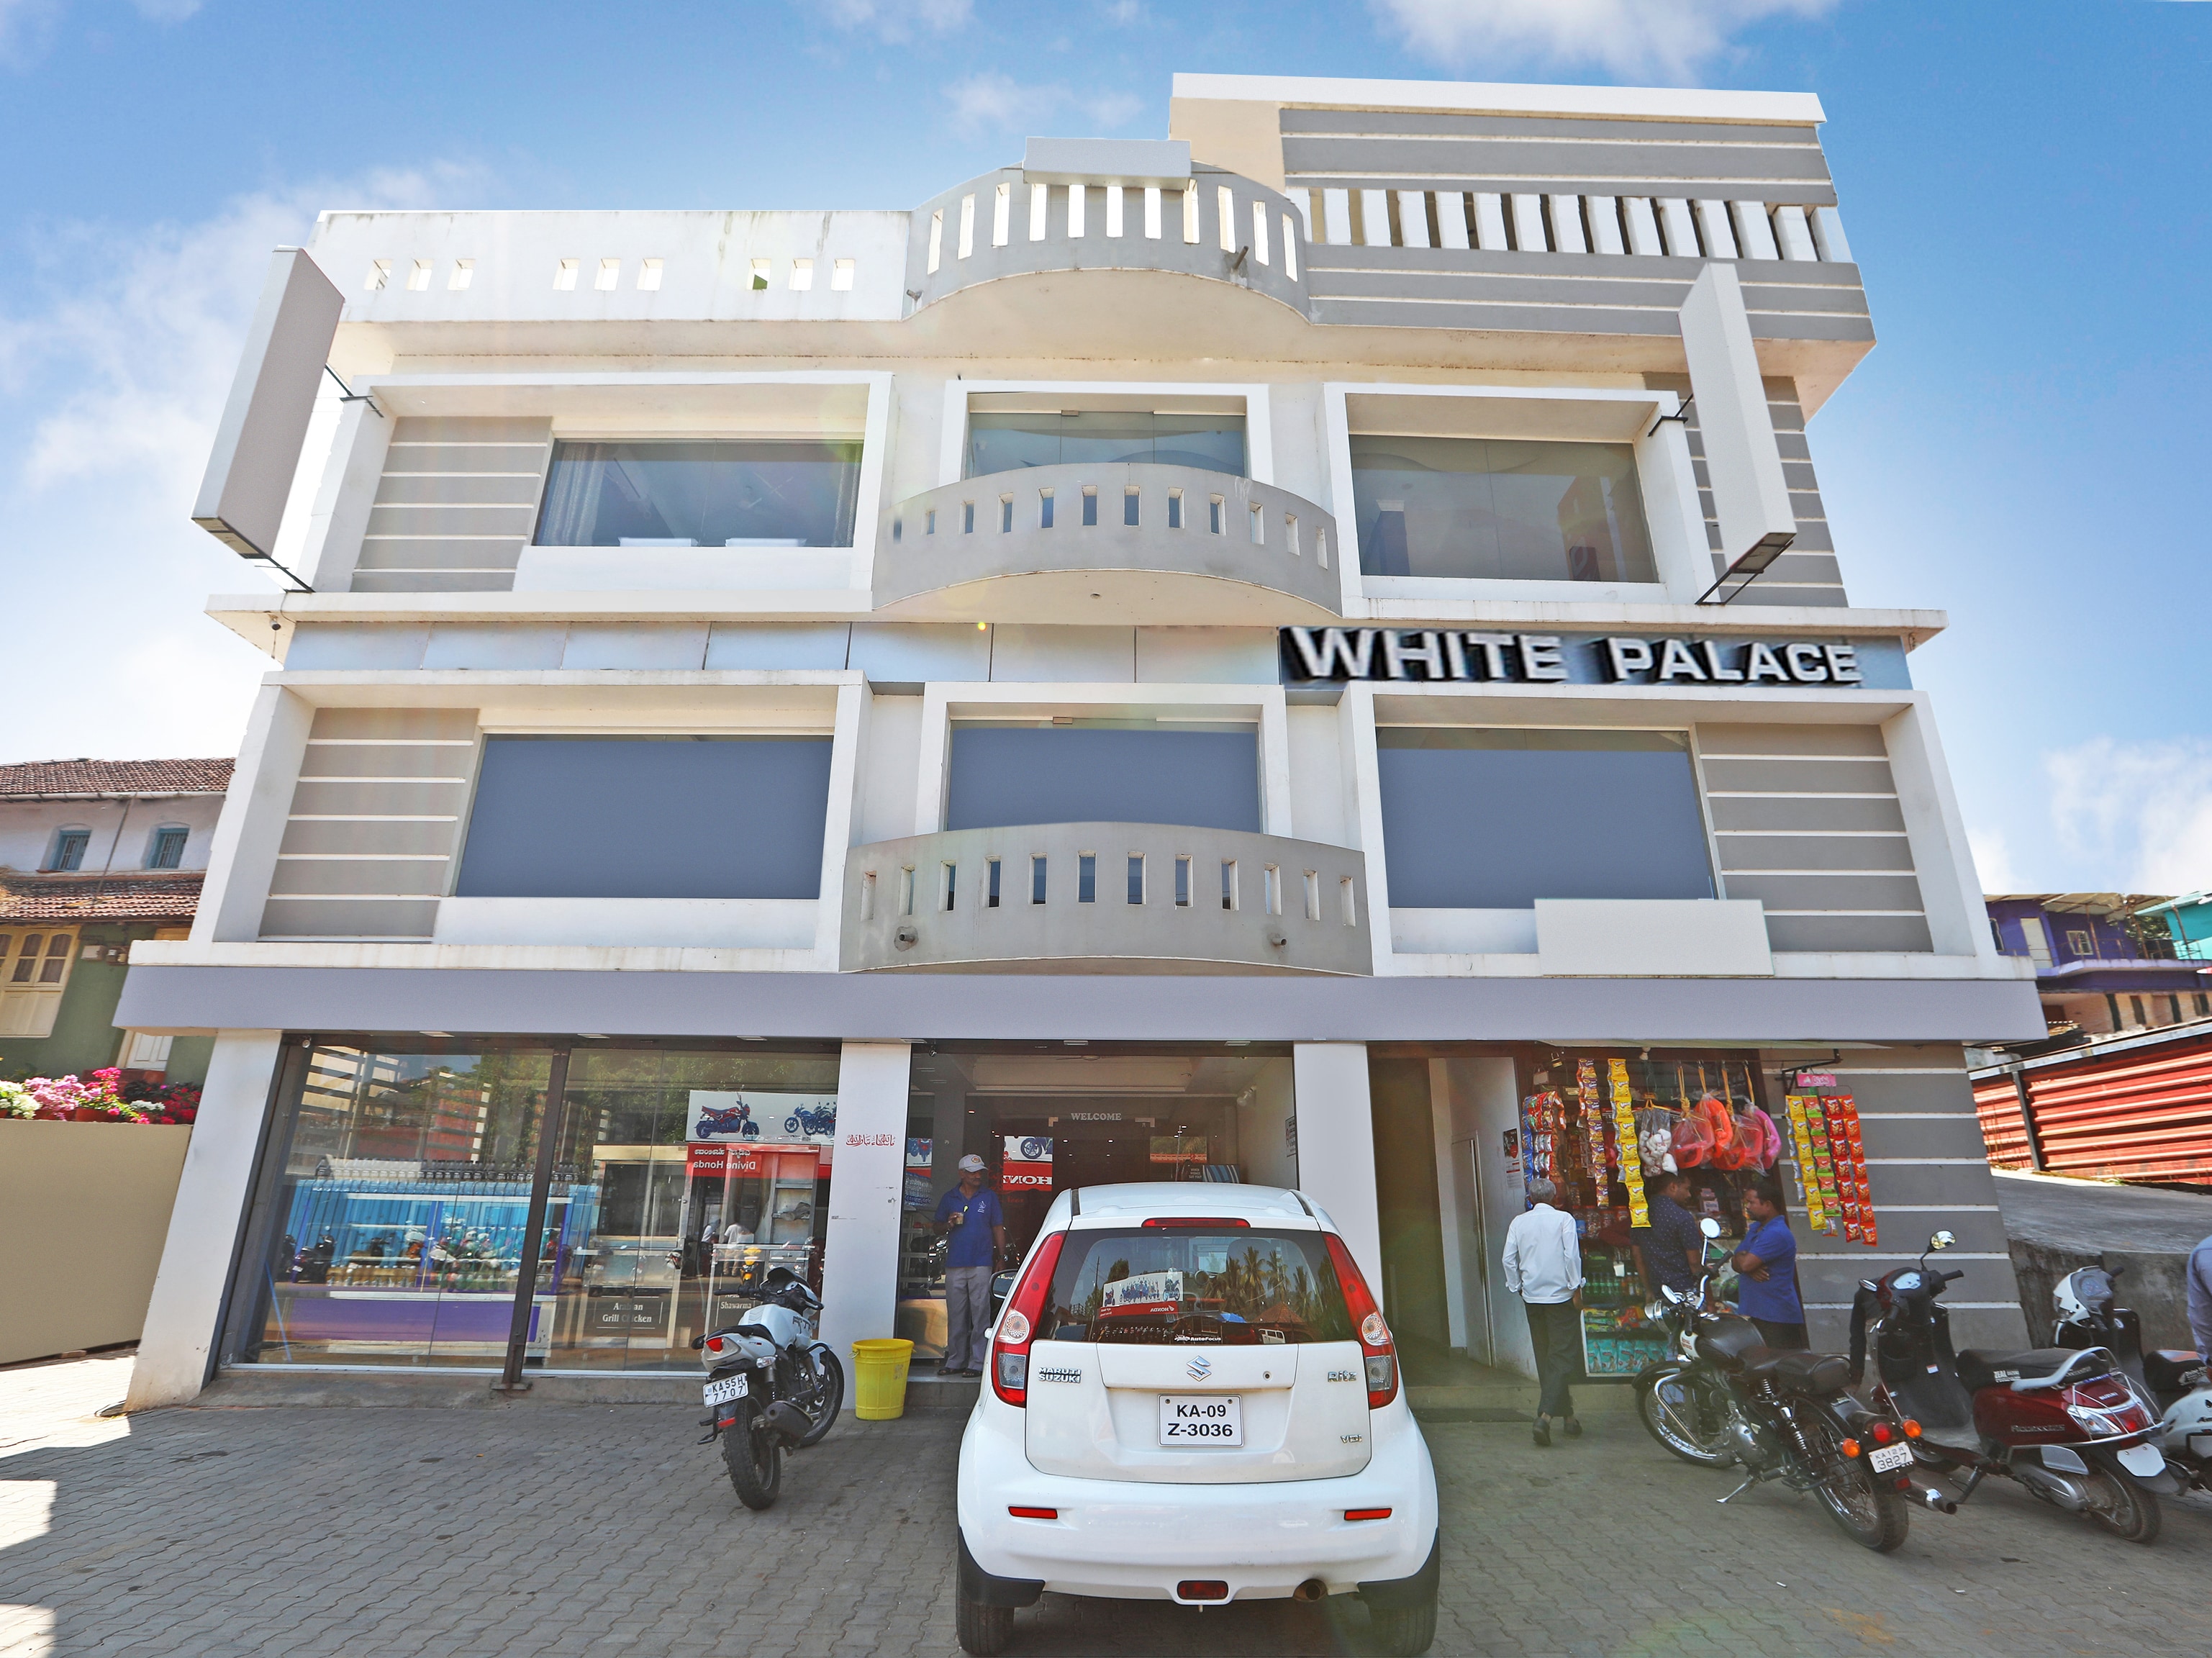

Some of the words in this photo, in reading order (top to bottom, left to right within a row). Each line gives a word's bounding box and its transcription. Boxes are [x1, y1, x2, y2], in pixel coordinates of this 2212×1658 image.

[1289, 626, 1569, 682] WHITE
[1608, 637, 1864, 682] PALACE
[1038, 1373, 1082, 1383] SUZUKI
[1328, 1370, 1358, 1382] Ritz
[713, 1385, 743, 1403] 7707
[1177, 1404, 1226, 1418] KA-09
[1167, 1423, 1233, 1437] Z-3036
[1877, 1452, 1907, 1470] 3827
